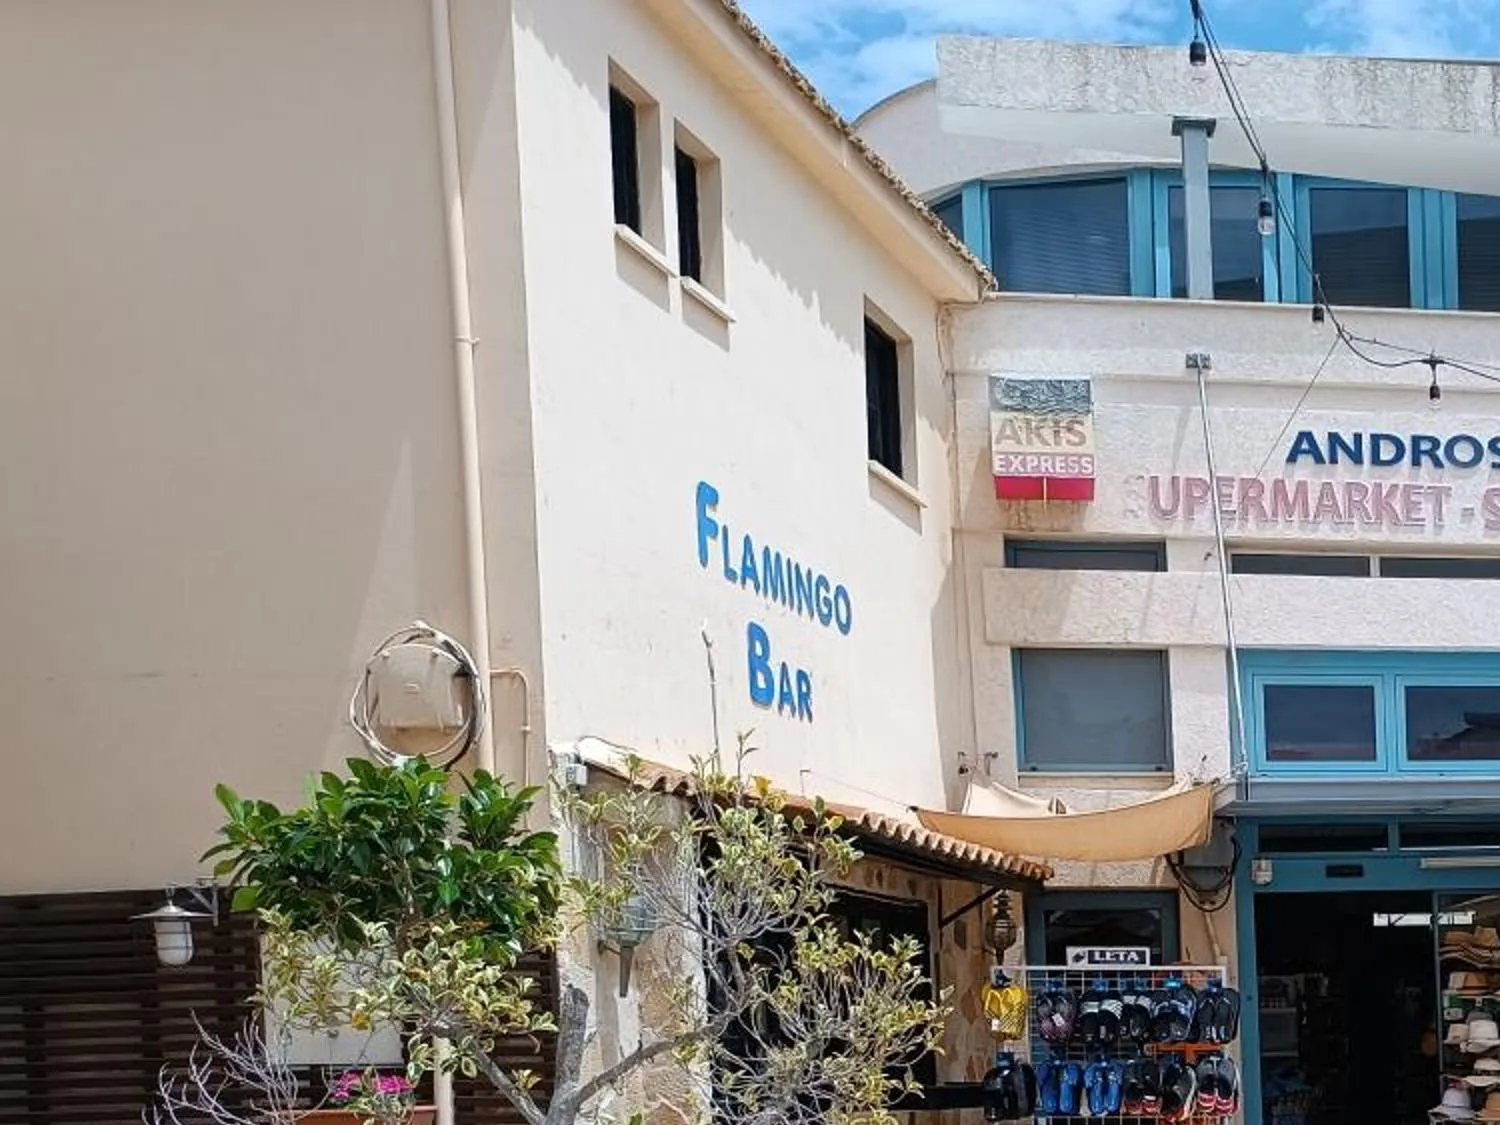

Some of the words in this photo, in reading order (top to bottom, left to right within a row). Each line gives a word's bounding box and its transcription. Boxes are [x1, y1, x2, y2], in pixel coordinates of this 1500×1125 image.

[996, 455, 1093, 474] EXPRESS
[1122, 474, 1452, 528] UPERMARKET
[695, 480, 852, 636] FLAMINGO
[746, 620, 813, 724] BAR
